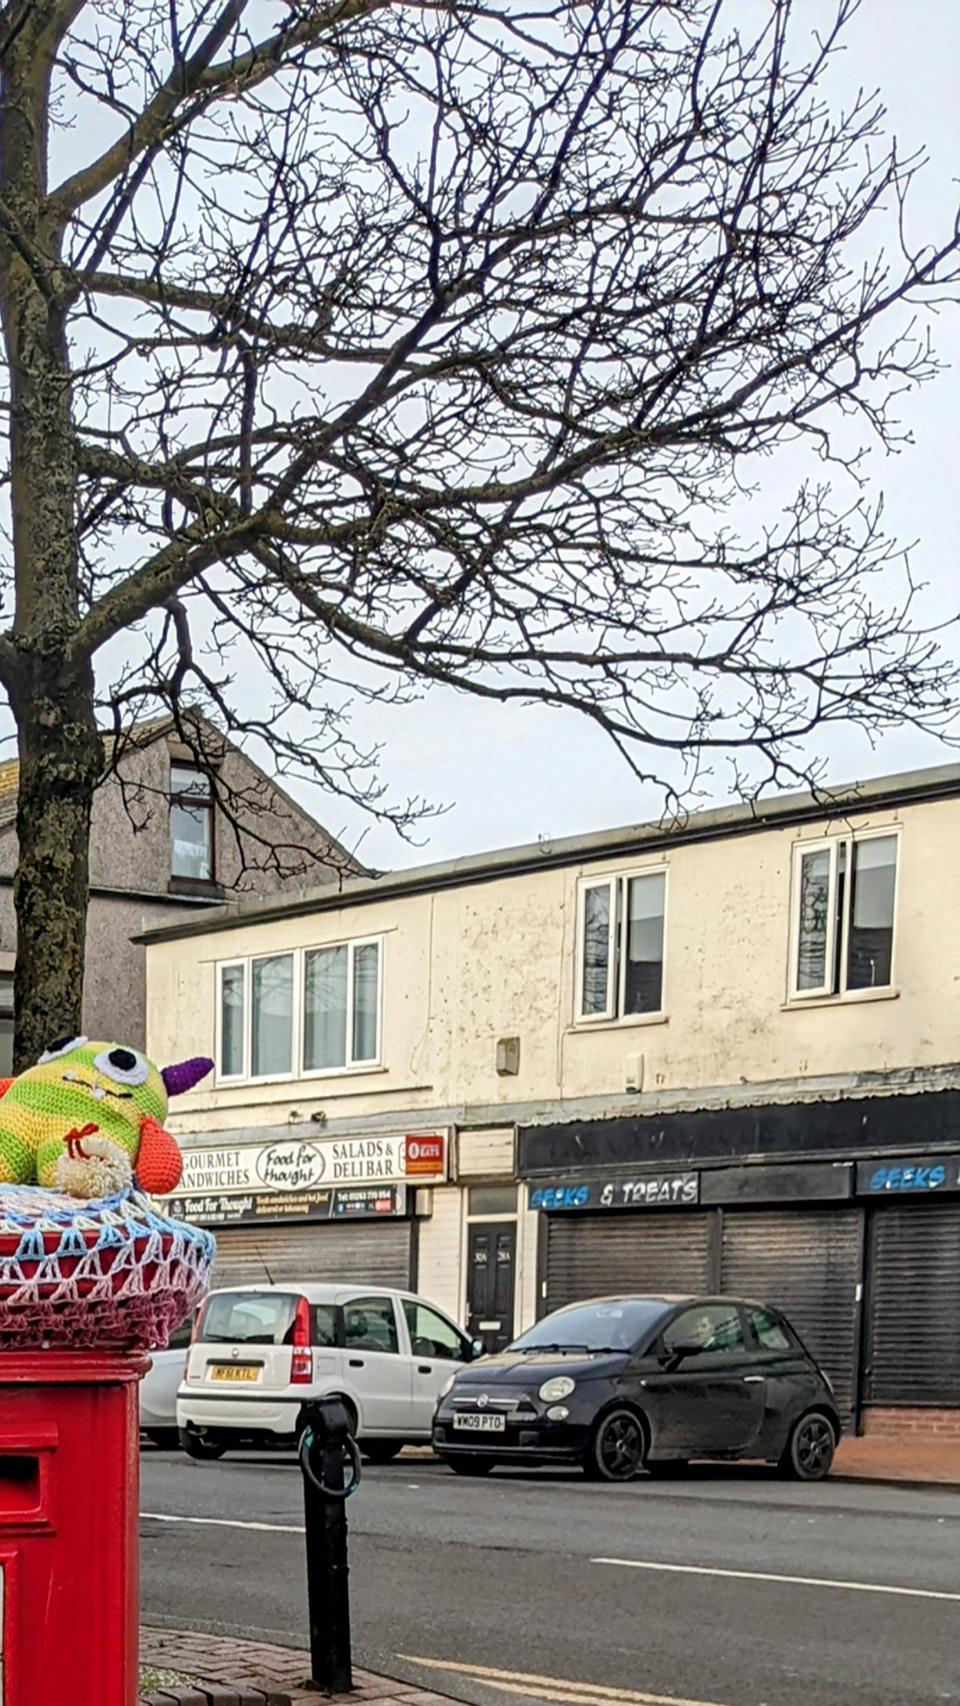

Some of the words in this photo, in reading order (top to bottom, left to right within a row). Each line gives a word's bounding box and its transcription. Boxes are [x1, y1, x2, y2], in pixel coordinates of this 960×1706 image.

[264, 1148, 292, 1166] Food
[297, 1147, 317, 1165] for
[333, 1141, 383, 1160] SALADS
[386, 1143, 393, 1156] &
[180, 1169, 250, 1188] ANDWICHES
[264, 1164, 315, 1186] thought
[334, 1162, 364, 1179] DELI
[366, 1159, 394, 1177] BAR
[601, 1184, 613, 1206] &
[623, 1178, 698, 1203] TREATS
[185, 1199, 204, 1213] Food
[205, 1198, 218, 1212] For
[219, 1196, 253, 1215] Thought
